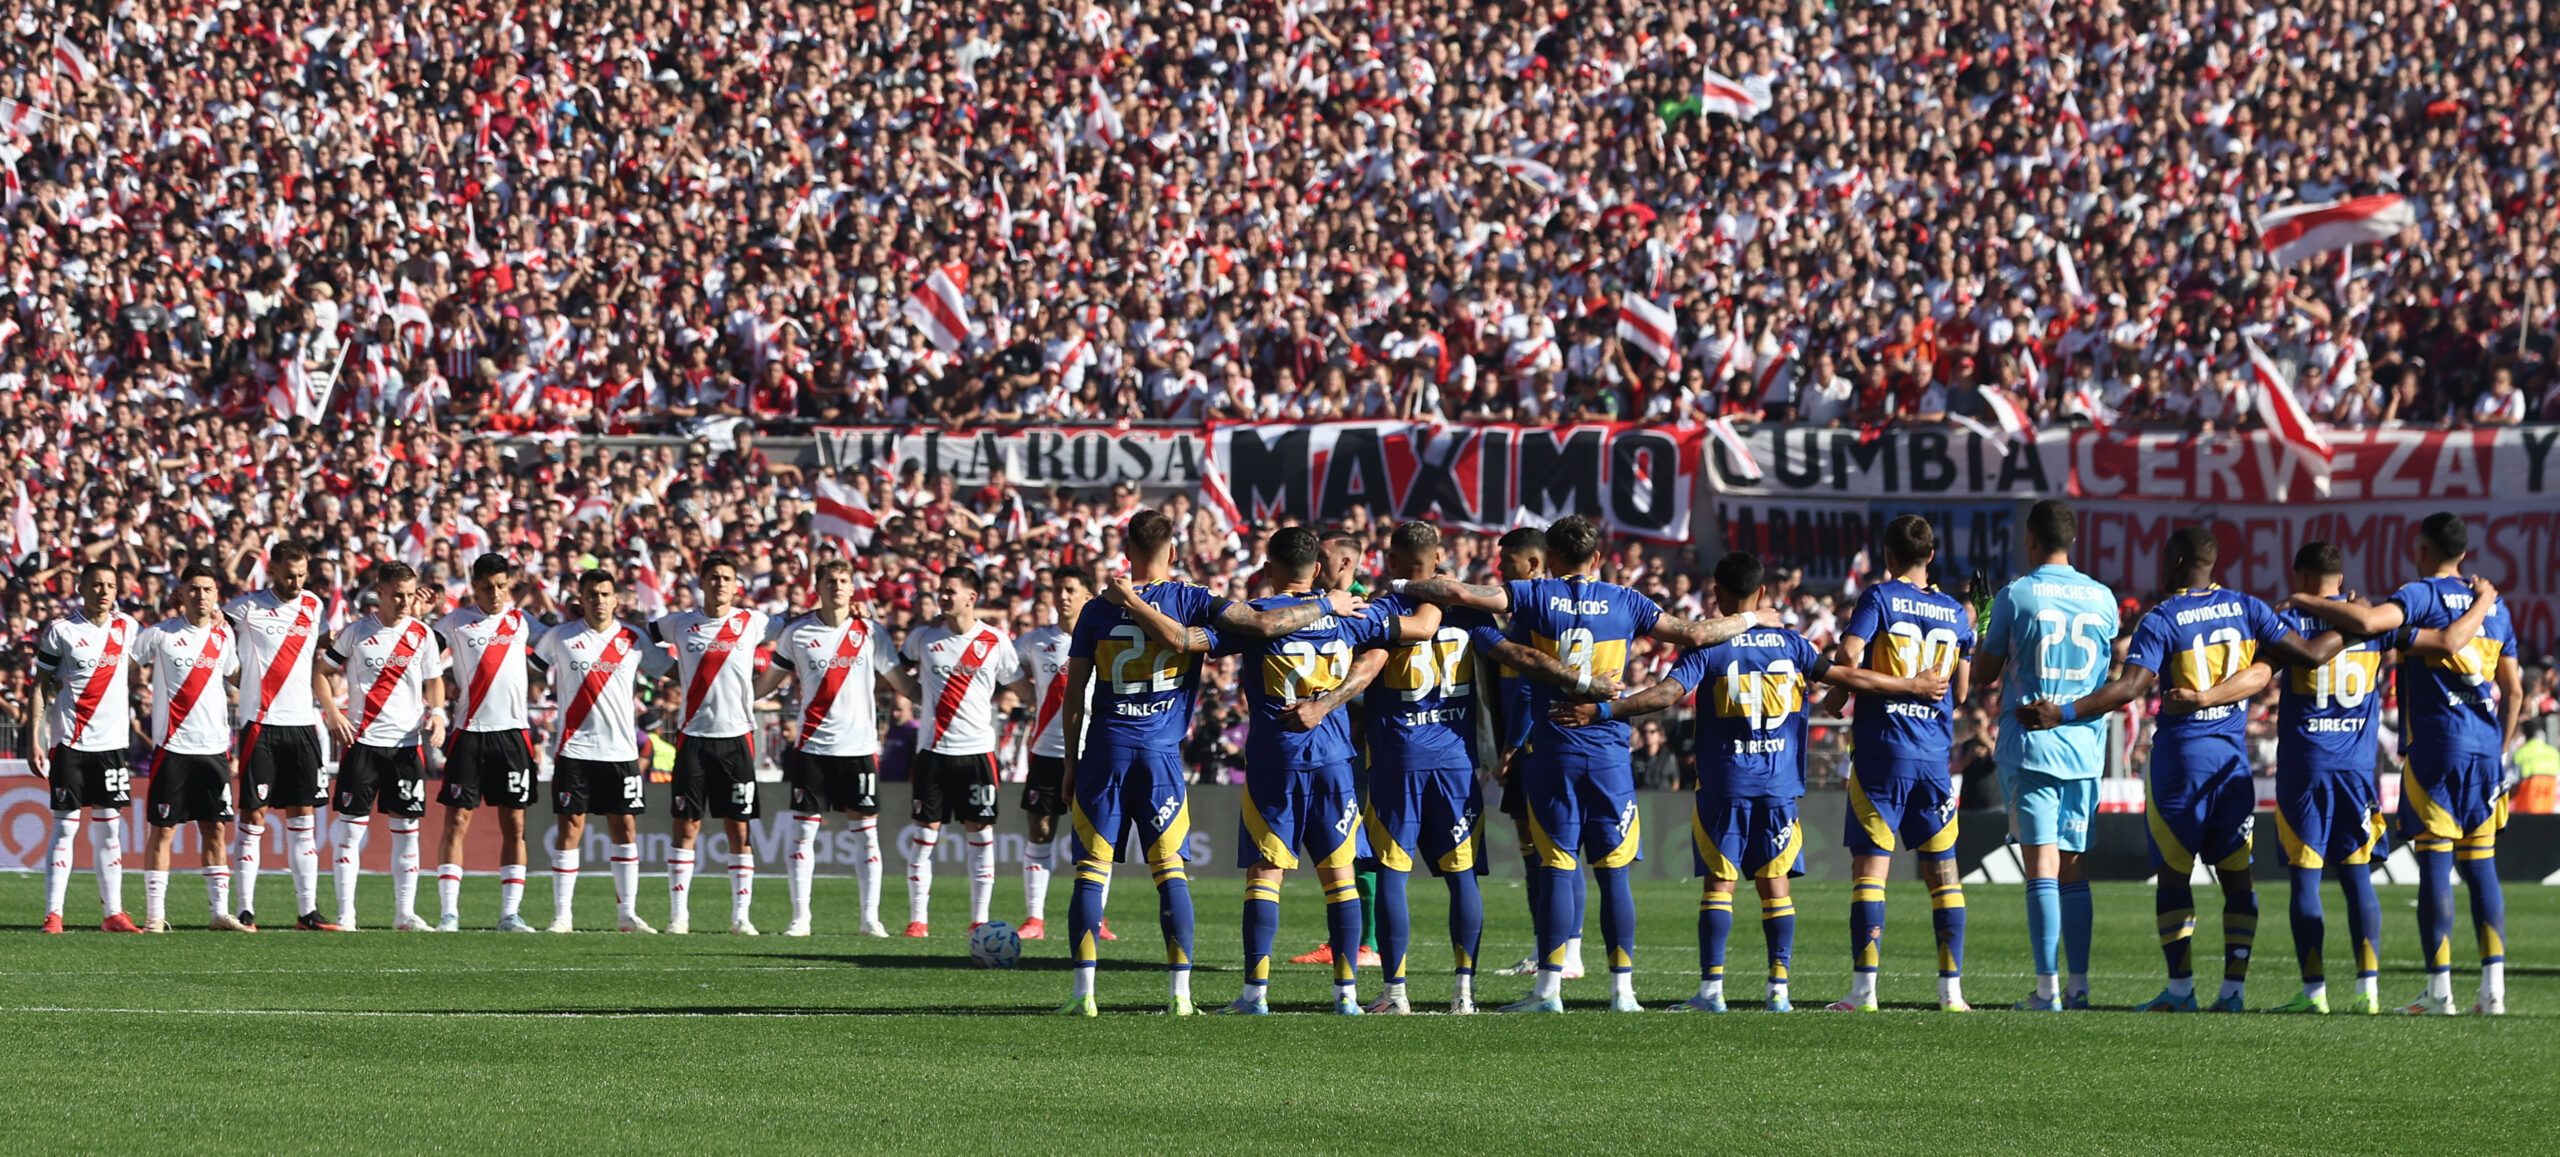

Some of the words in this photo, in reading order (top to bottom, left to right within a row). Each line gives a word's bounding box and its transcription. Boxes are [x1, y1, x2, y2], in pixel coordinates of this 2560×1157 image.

[1027, 431, 1200, 481] ROSA
[2077, 431, 2484, 501] CERVEZA
[1230, 427, 1680, 530] MAXIMO
[1550, 596, 1609, 616] PALACIOS
[1892, 597, 1957, 624] BELMONTE
[2176, 601, 2243, 627] ADVINCULA
[1109, 624, 1185, 695] 22
[2035, 608, 2104, 682] 25
[1401, 626, 1471, 702] 32
[2316, 642, 2367, 710] 16
[1727, 659, 1799, 731] 43
[1405, 707, 1467, 726] DIRECTV
[2307, 717, 2367, 733] DIRECTV
[1734, 738, 1786, 754] DIRECTV
[104, 767, 131, 792] 22
[397, 779, 425, 802] 34
[508, 768, 530, 793] 24
[623, 775, 643, 799] 21
[858, 772, 876, 796] 11
[968, 784, 996, 806] 30
[1150, 795, 1180, 833] pax
[1335, 798, 1357, 837] pax
[1450, 807, 1476, 844] pax
[1615, 799, 1638, 838] pax
